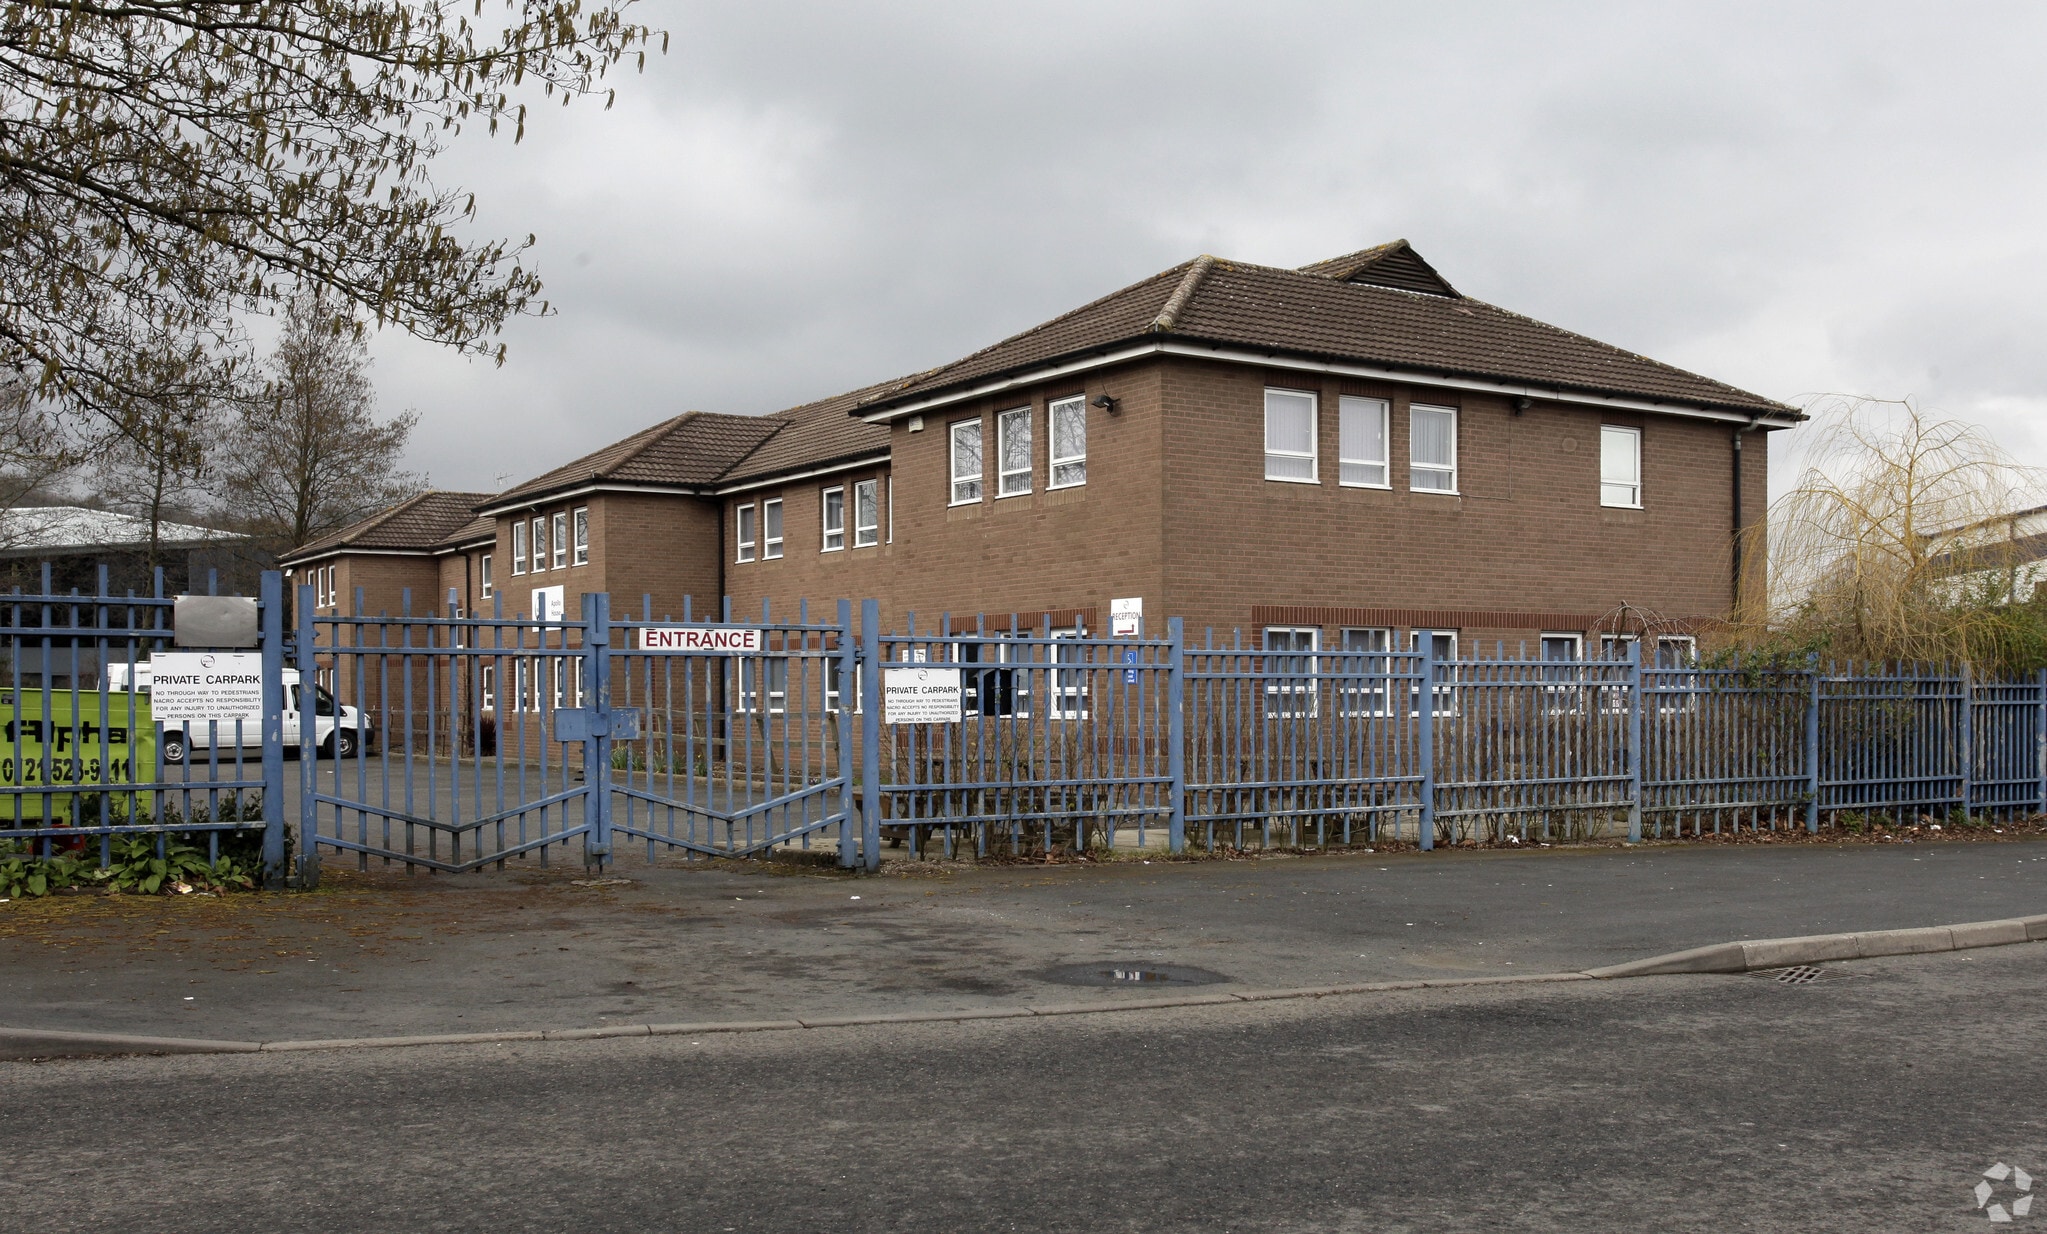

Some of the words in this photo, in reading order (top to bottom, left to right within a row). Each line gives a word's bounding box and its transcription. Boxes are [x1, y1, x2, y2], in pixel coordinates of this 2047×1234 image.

[1112, 611, 1141, 621] RECEPTION
[646, 631, 754, 648] ENTRANCE
[153, 675, 201, 685] PRIVATE
[206, 674, 261, 684] CARPARK
[886, 686, 918, 695] PRIVATE
[921, 686, 959, 694] CARPARK
